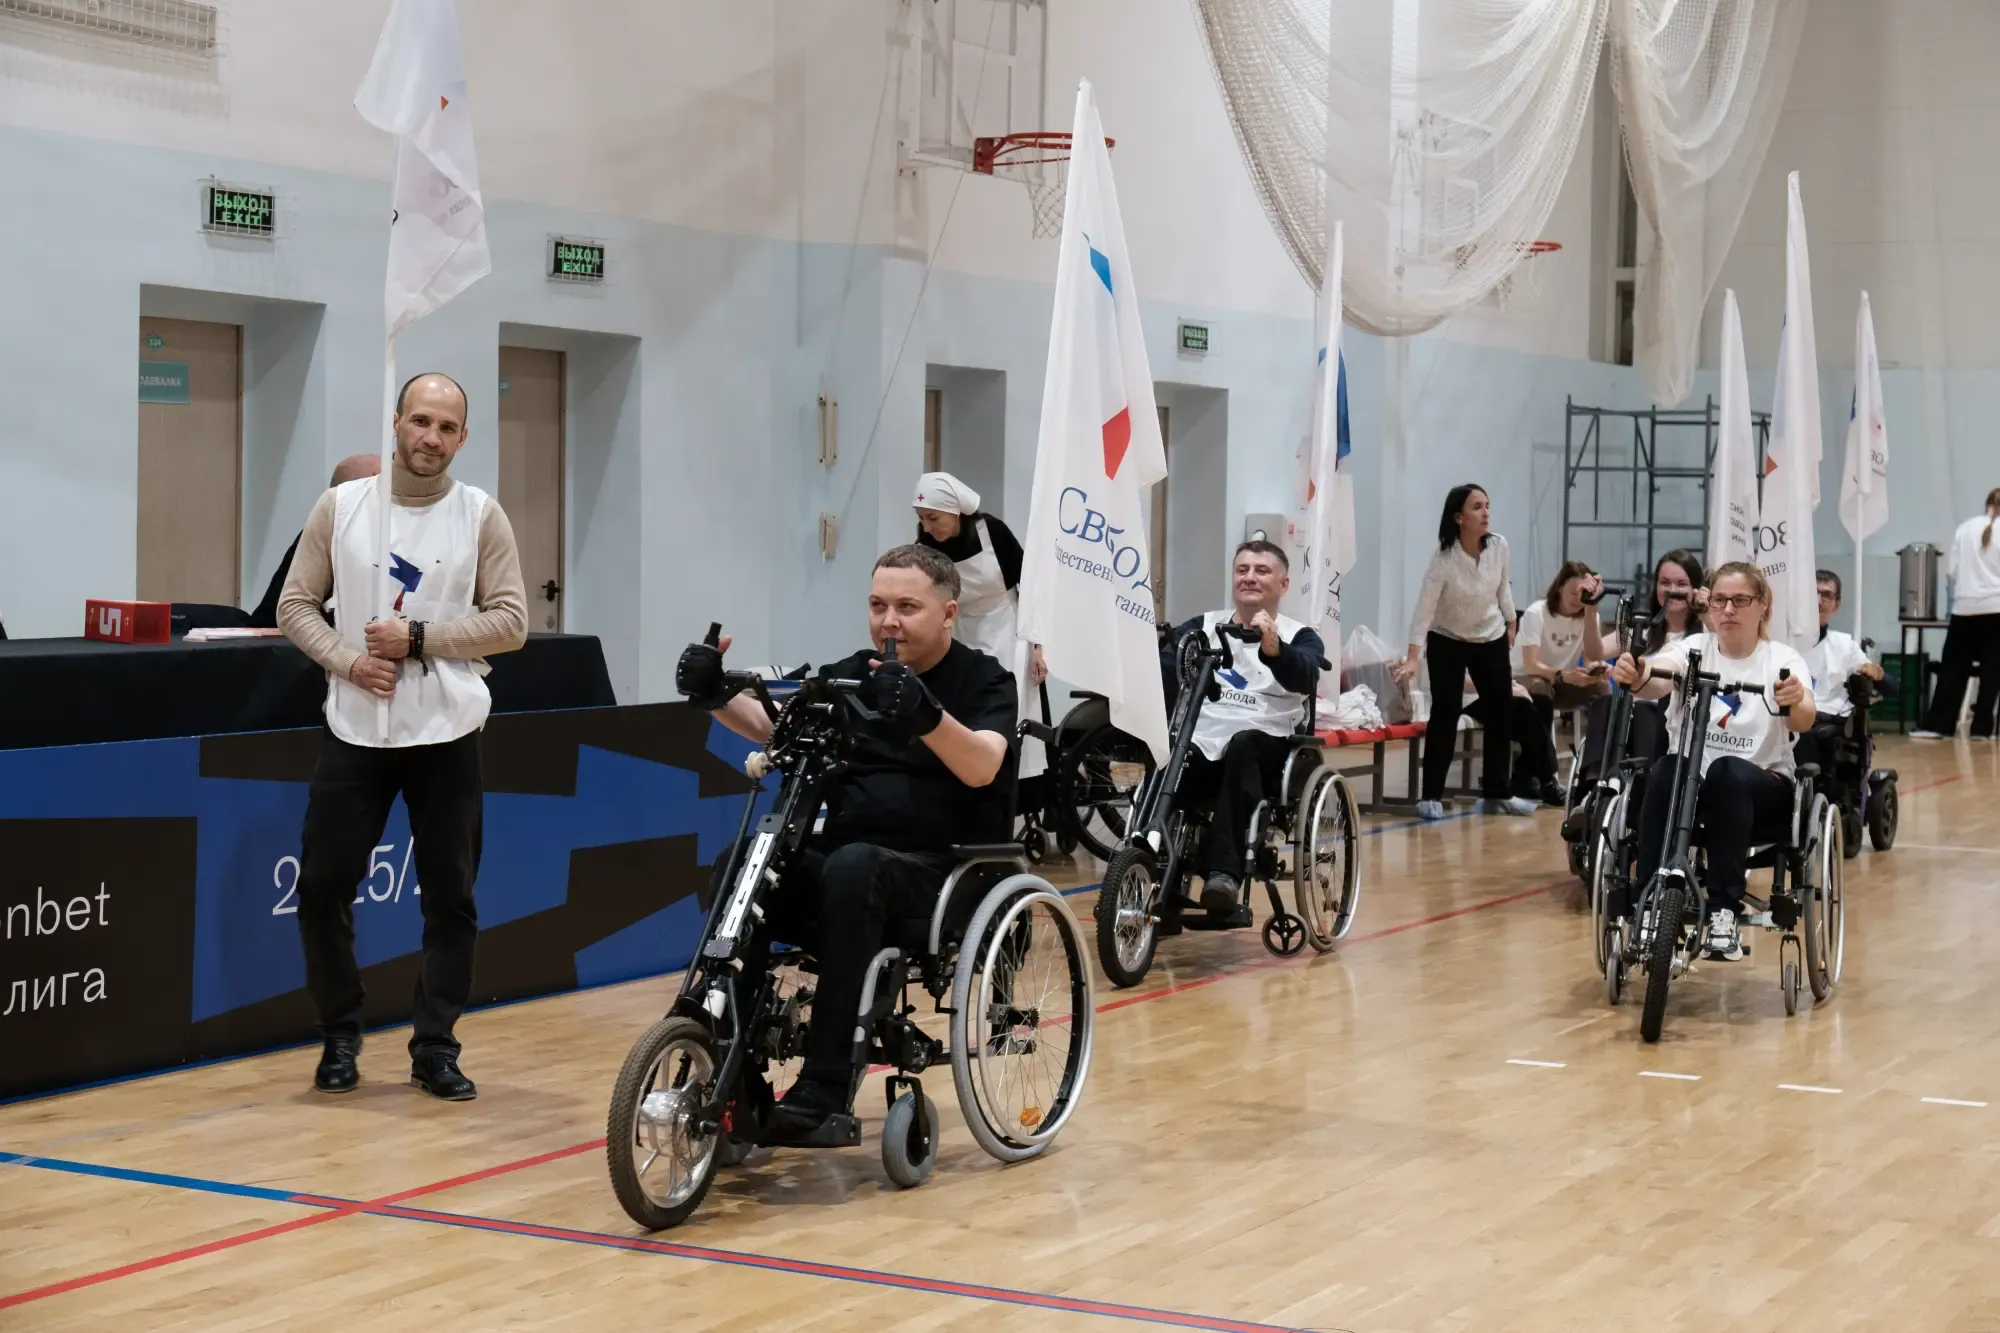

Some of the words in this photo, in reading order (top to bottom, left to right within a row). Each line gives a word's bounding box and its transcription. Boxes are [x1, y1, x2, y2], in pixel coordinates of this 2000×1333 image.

[215, 193, 269, 217] ВЫХОД
[221, 211, 260, 225] EXIT
[557, 246, 600, 265] ВЫХОД
[563, 261, 593, 273] EXIT
[1705, 731, 1754, 749] вобода
[0, 881, 111, 939] nbet
[3, 967, 107, 1016] лига
